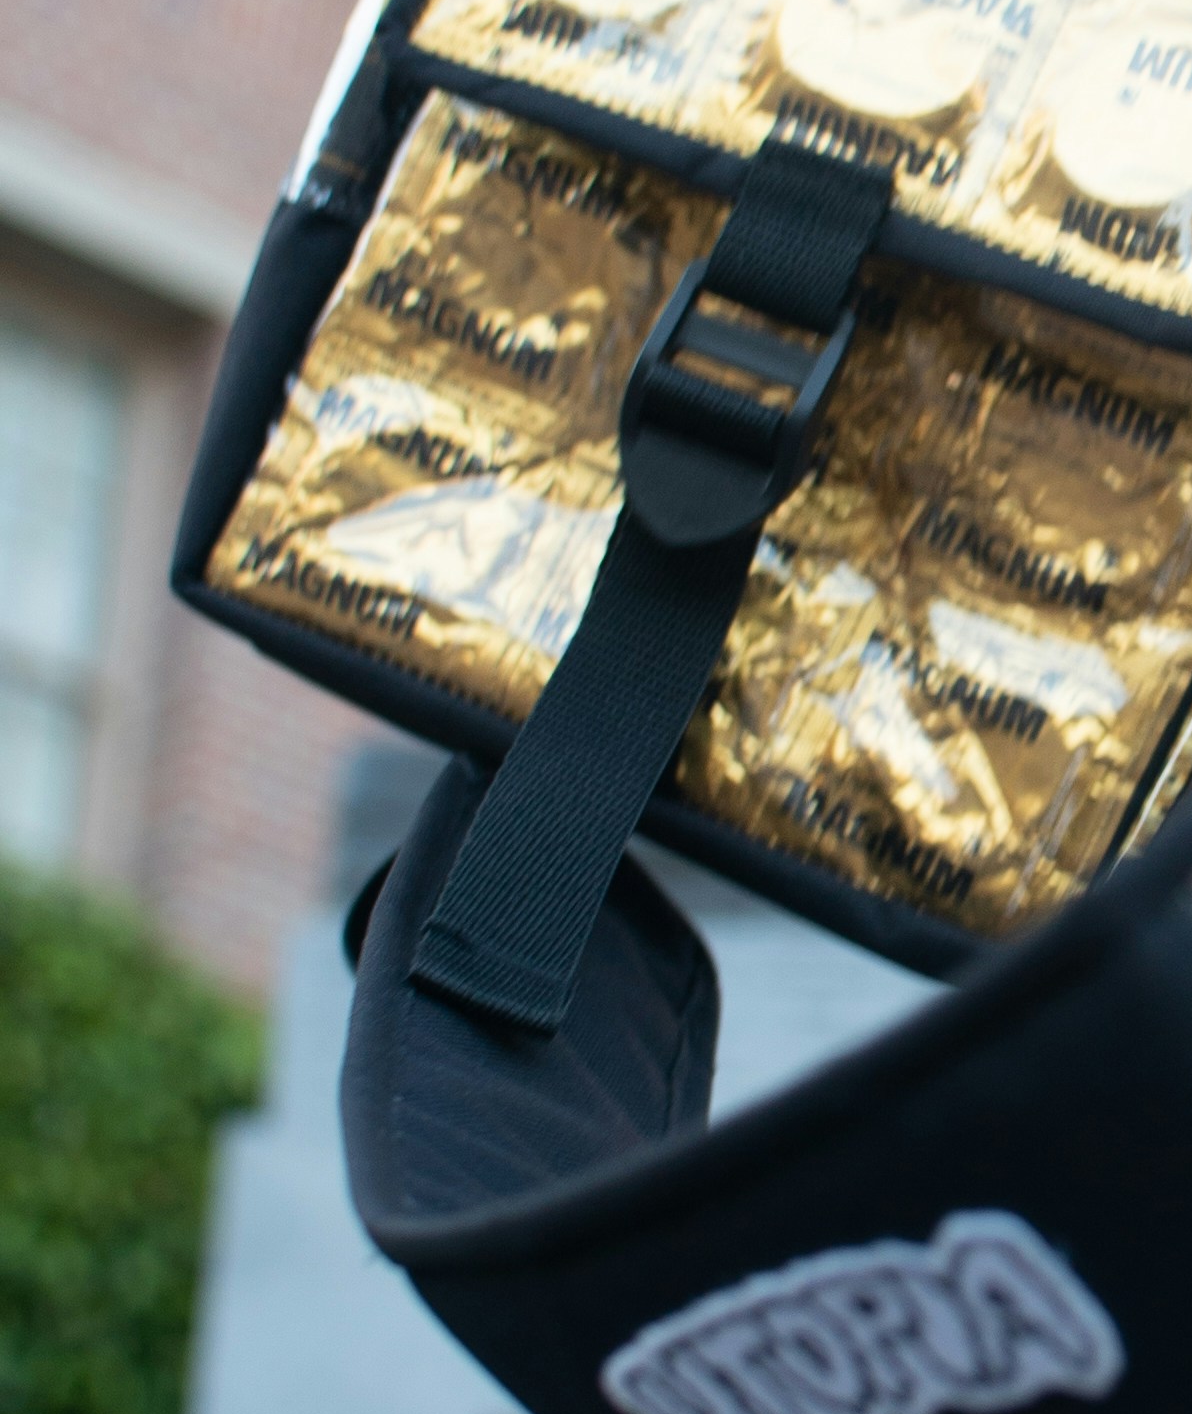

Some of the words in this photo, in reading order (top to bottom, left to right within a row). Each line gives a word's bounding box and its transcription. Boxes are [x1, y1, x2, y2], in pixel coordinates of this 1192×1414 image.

[364, 267, 556, 381] MAGNUM
[980, 343, 1177, 456] MAGNUM
[237, 536, 423, 640] MAGNUM
[917, 505, 1108, 611] MAGNUM
